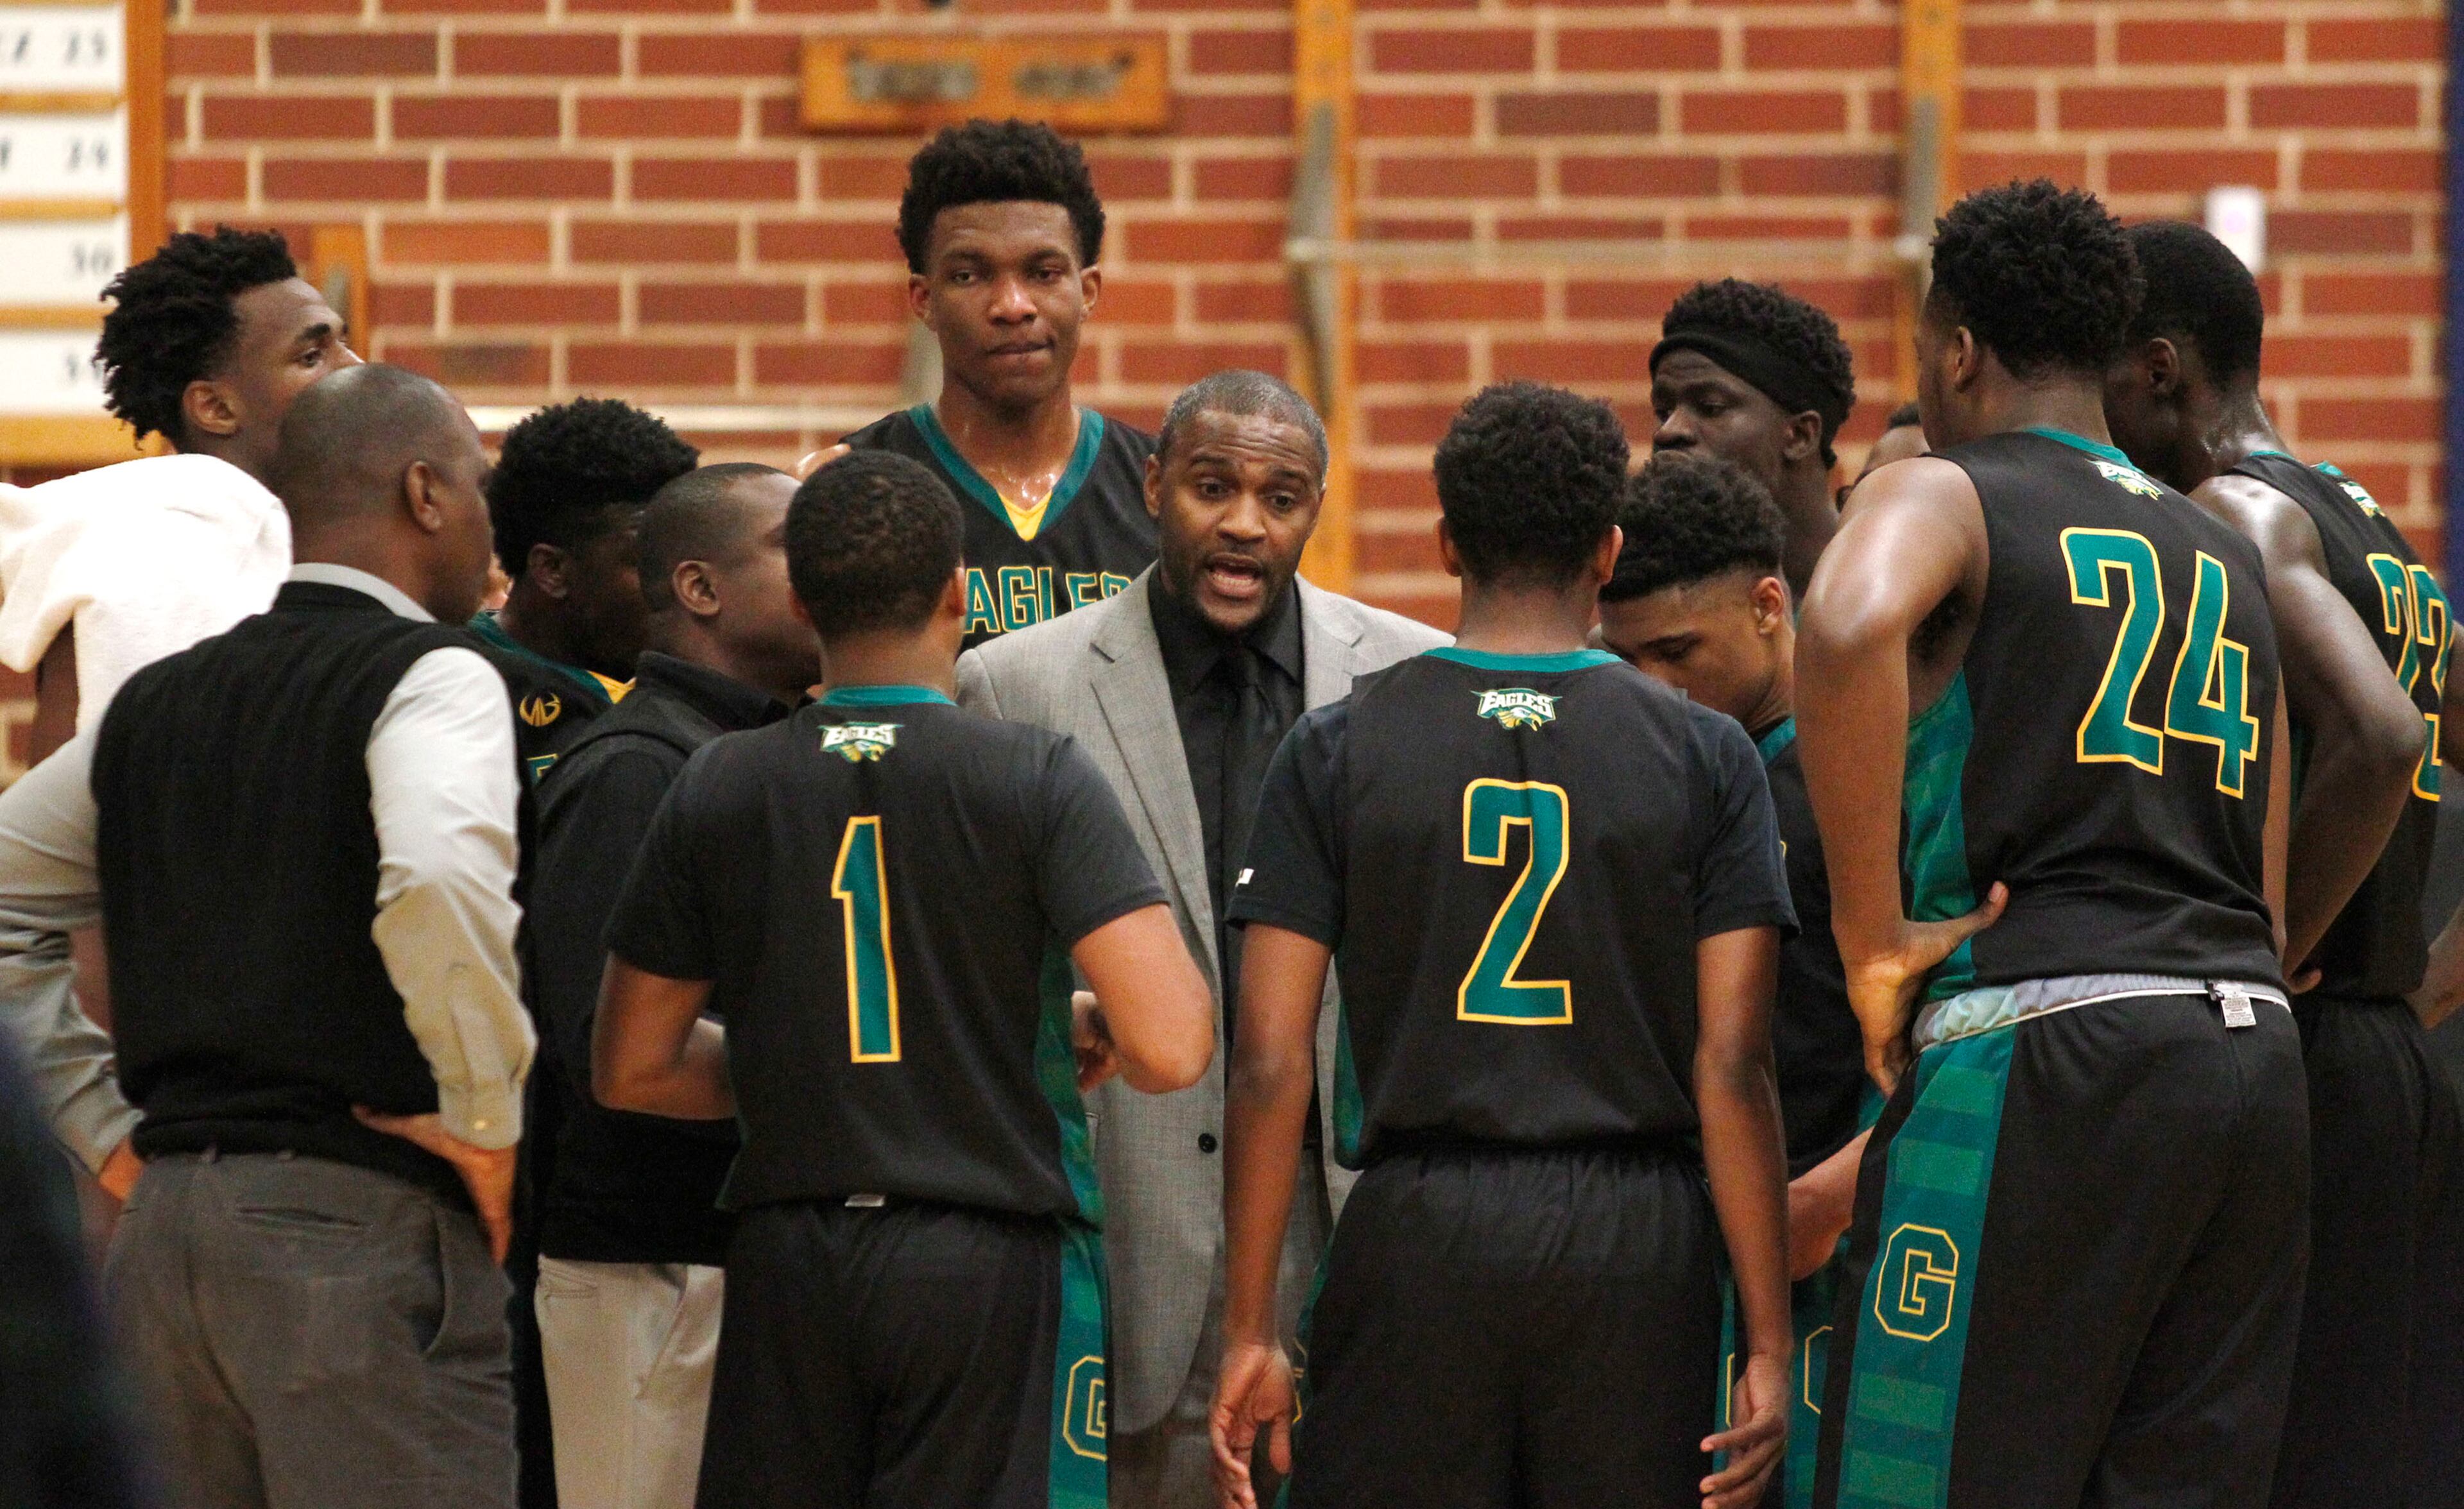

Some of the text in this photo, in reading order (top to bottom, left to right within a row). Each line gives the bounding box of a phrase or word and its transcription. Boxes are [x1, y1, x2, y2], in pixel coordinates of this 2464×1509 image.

[963, 566, 1132, 635] AGLE
[1478, 690, 1556, 720] EAGLES
[2060, 527, 2259, 799] 24
[821, 724, 896, 749] EAGLES
[831, 815, 901, 1063] 1
[1457, 778, 1573, 1025] 2
[1874, 1223, 1959, 1342] G
